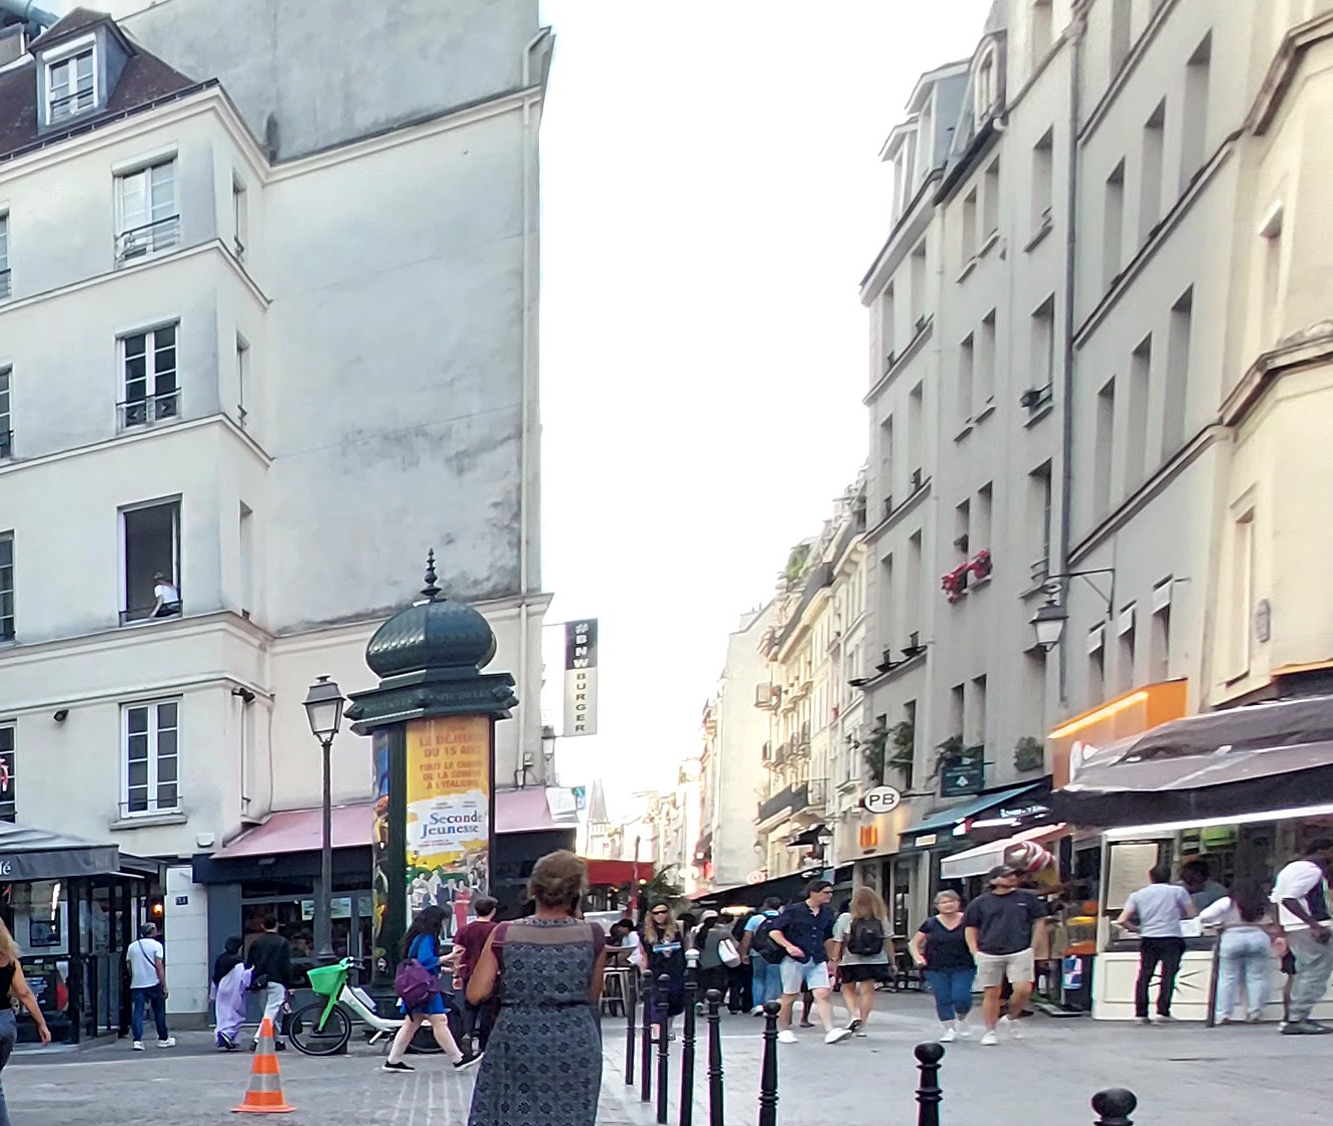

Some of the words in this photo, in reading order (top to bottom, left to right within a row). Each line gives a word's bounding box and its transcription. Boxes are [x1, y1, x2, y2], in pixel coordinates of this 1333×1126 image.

[575, 673, 587, 731] BURGER
[869, 794, 895, 806] PB
[429, 810, 482, 826] Seconde
[419, 824, 480, 839] Jeunesse
